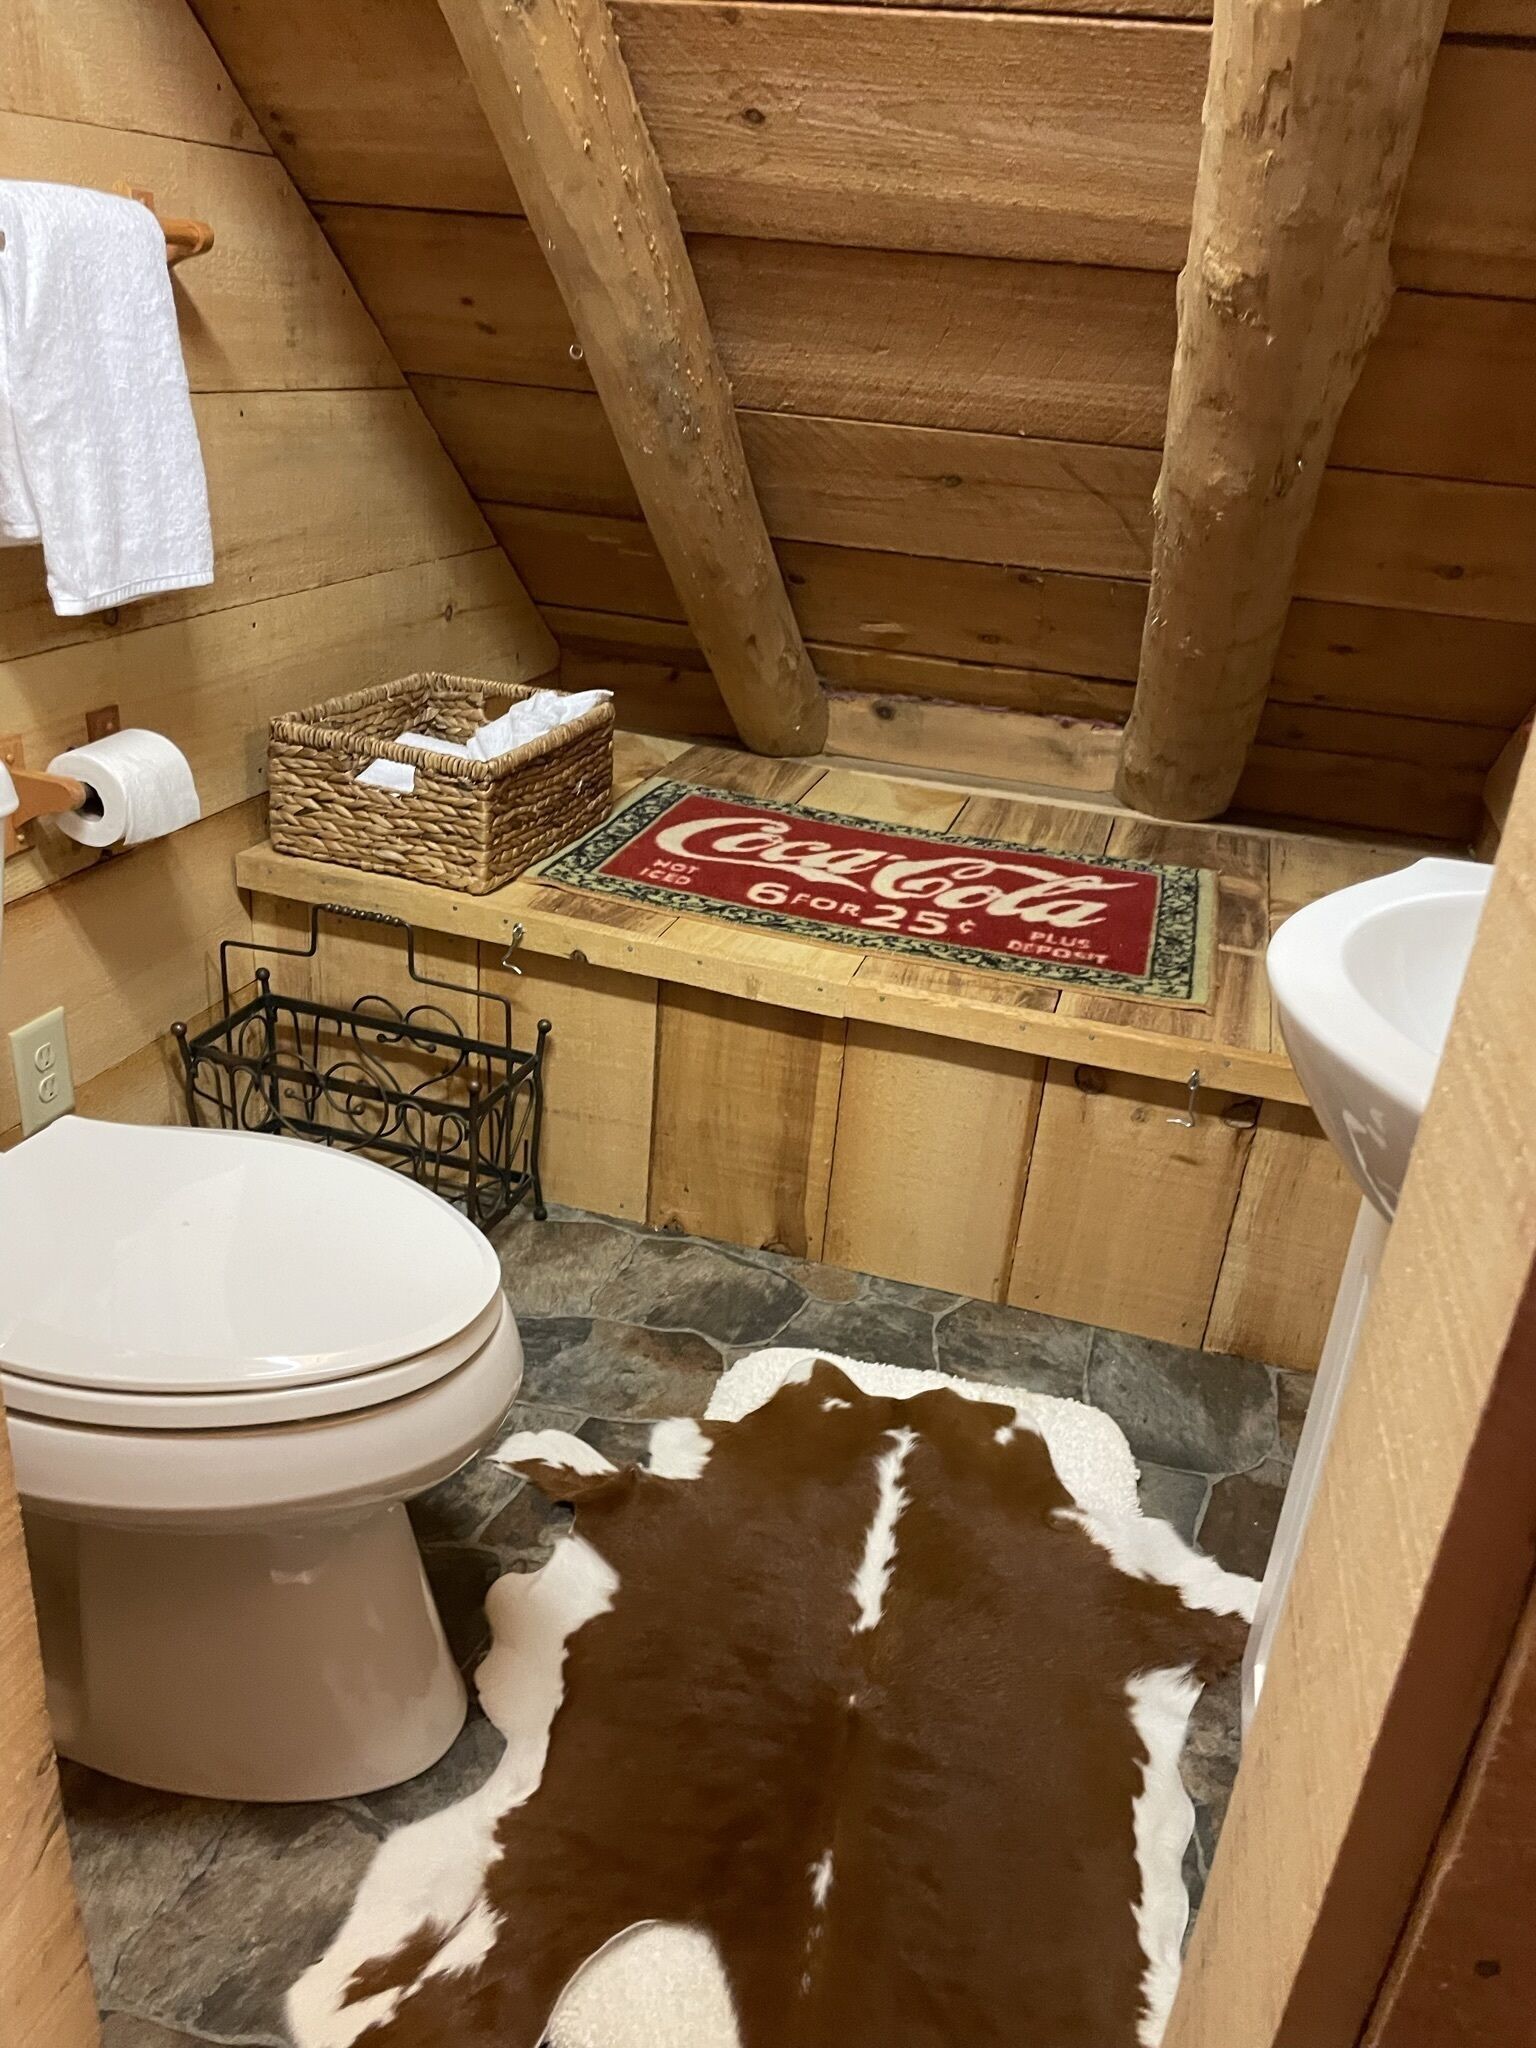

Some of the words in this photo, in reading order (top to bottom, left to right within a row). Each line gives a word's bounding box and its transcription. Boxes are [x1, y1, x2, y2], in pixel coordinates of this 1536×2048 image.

[652, 859, 699, 875] NOT
[640, 868, 692, 886] ICED
[747, 882, 790, 905] 6
[790, 893, 862, 917] FOR
[1030, 931, 1092, 949] PLUS
[1007, 940, 1109, 965] DEPOSIT
